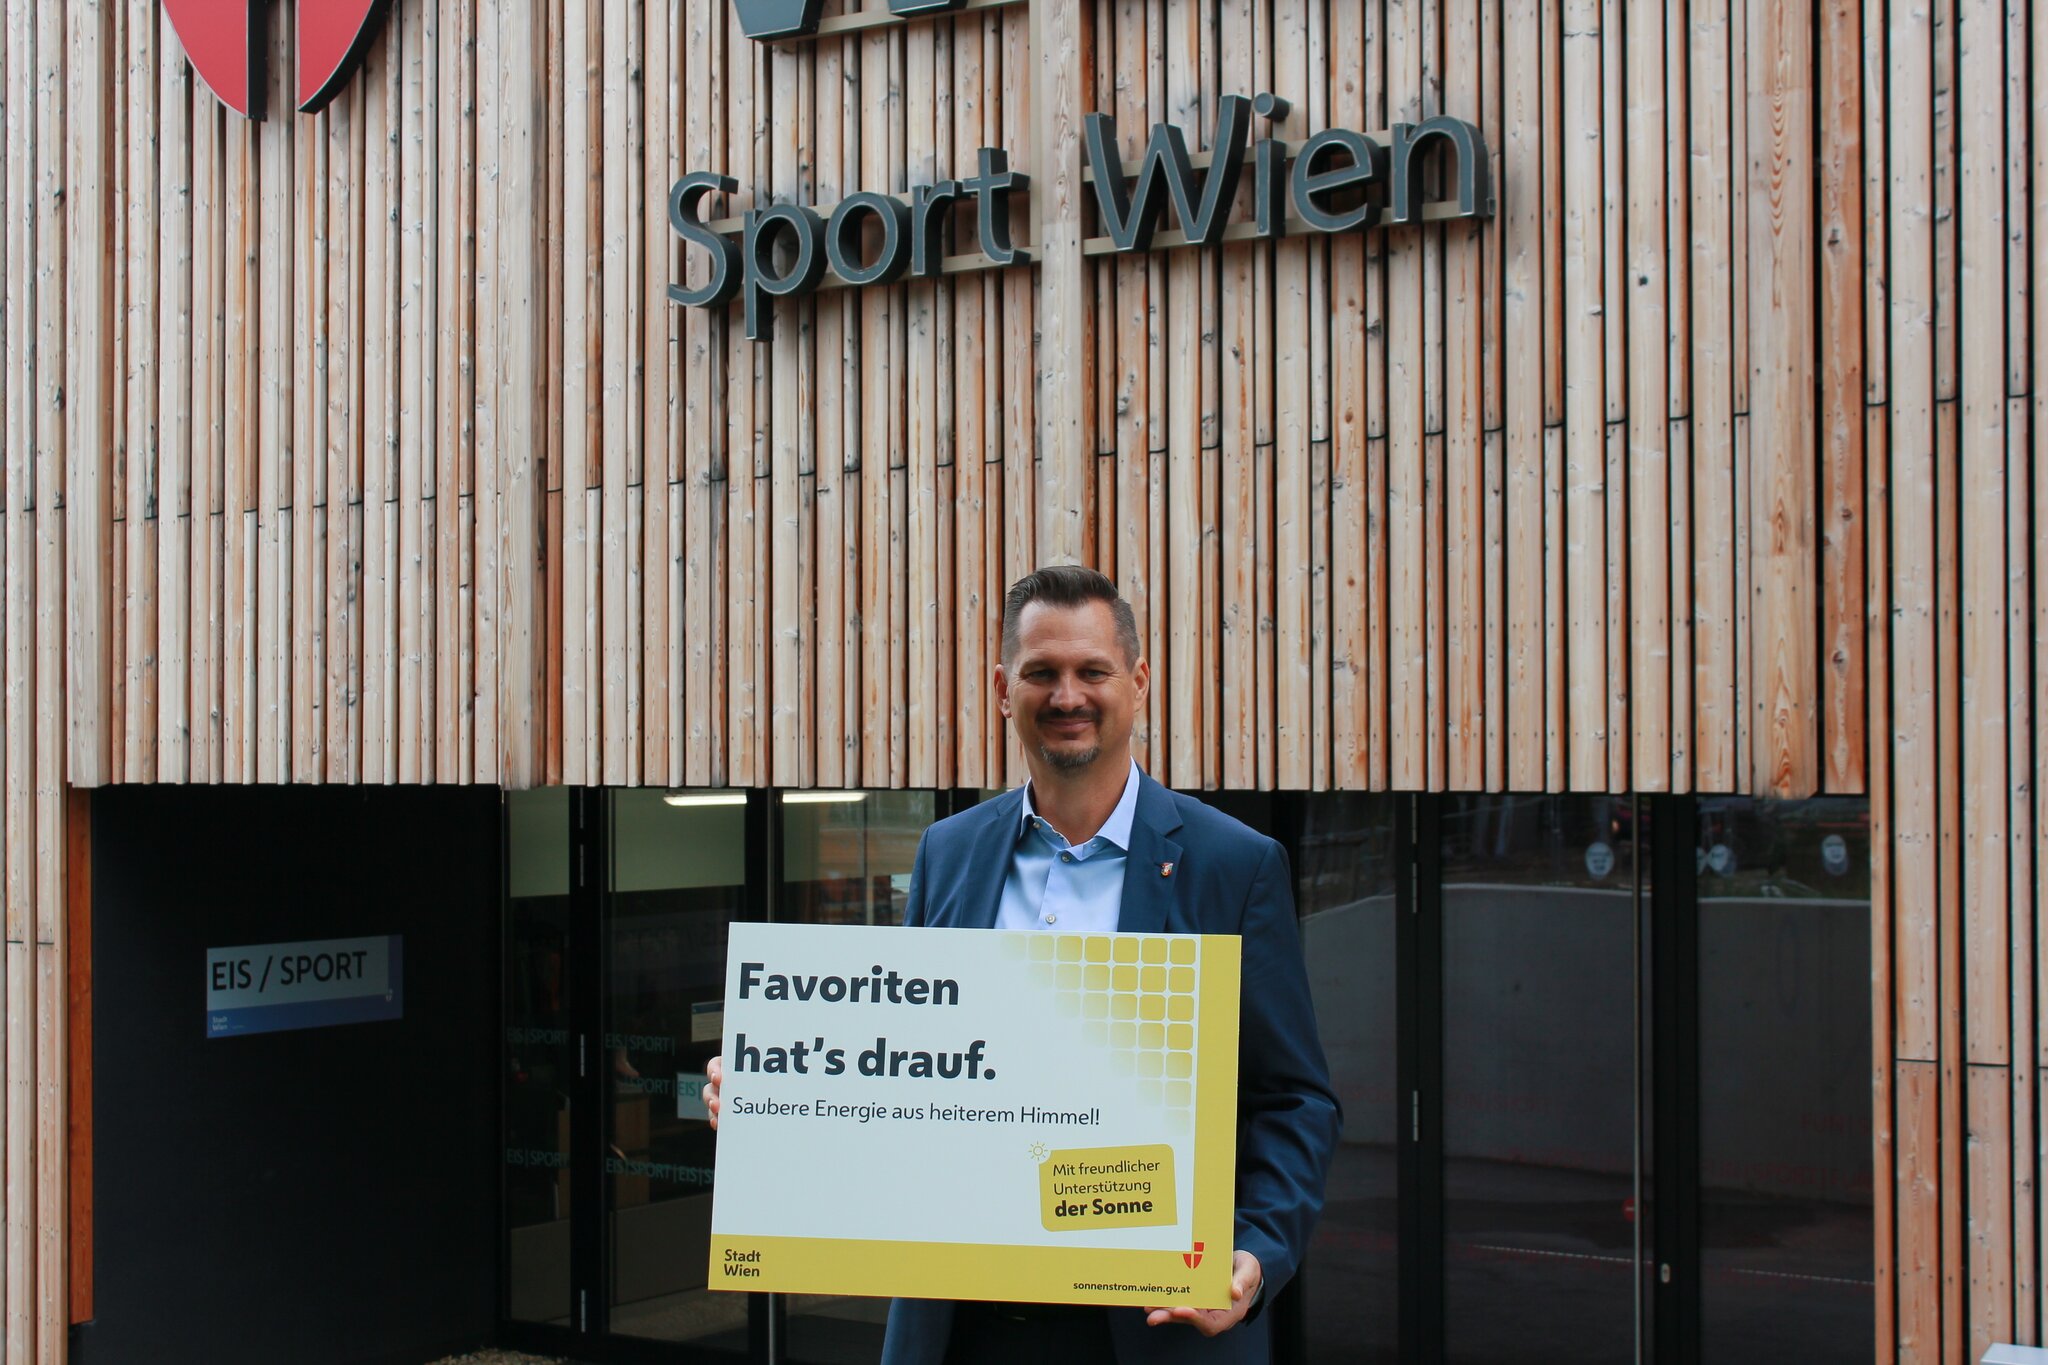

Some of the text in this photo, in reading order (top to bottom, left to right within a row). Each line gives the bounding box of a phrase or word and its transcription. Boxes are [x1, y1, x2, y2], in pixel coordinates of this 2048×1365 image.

[667, 92, 1492, 342] Sport Wien
[211, 958, 251, 992] EIS
[280, 951, 368, 985] SPORT
[738, 961, 960, 1006] Favoriten
[733, 1033, 997, 1081] hat’s drauf.
[732, 1096, 1101, 1126] Saubere Energie aus heiterem Himmel!
[1053, 1159, 1161, 1177] Mit freundlicher
[1053, 1179, 1152, 1196] Unterstützung
[1055, 1197, 1154, 1218] der Sonne
[724, 1248, 761, 1263] Stadt
[724, 1263, 760, 1277] Wien
[1073, 1280, 1191, 1296] sonnenstrom.wien.gv.at
